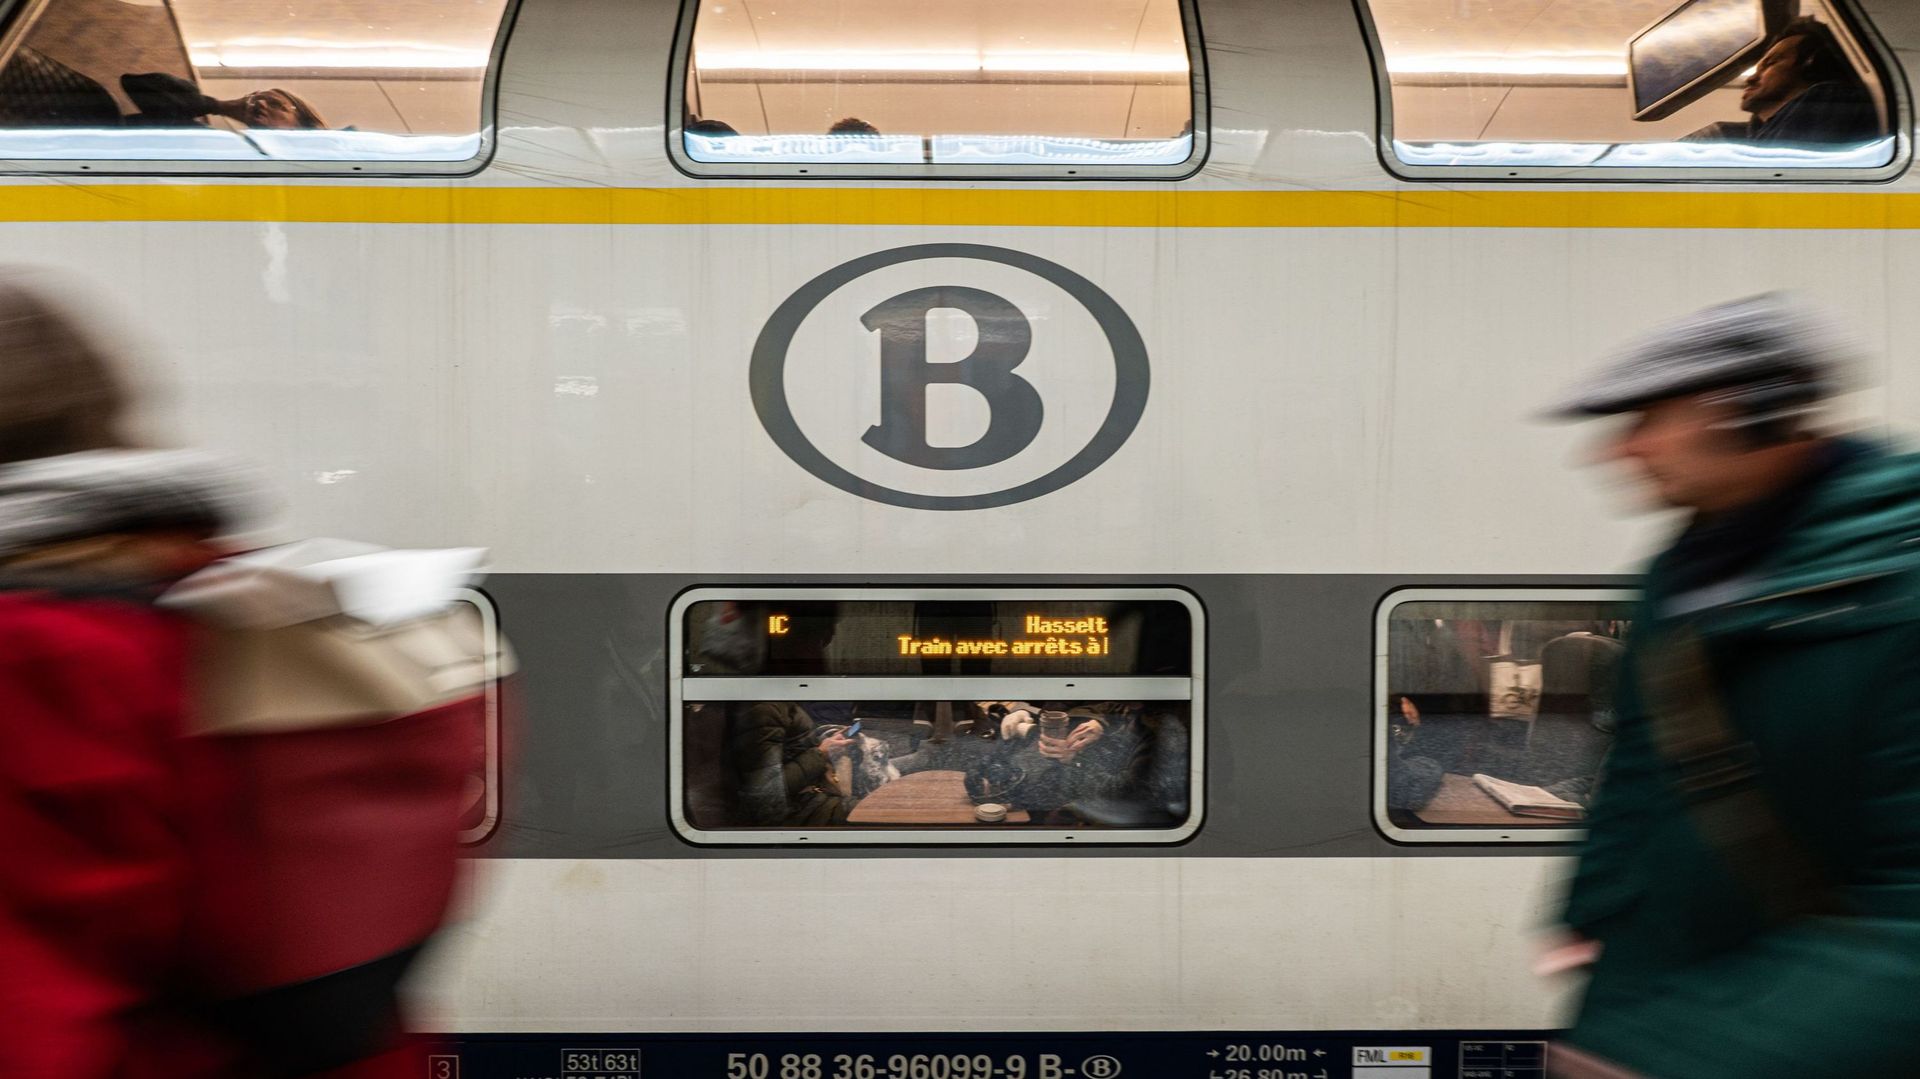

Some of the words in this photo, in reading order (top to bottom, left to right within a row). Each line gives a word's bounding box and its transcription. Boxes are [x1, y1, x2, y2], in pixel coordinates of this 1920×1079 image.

[860, 285, 1044, 470] B
[769, 615, 789, 634] IC
[1025, 615, 1108, 634] Hasselt
[897, 636, 953, 655] Train
[955, 640, 1009, 655] avec
[1011, 637, 1083, 655] arrêts
[1086, 637, 1101, 655] à
[1225, 1044, 1307, 1062] 20.00m
[437, 1060, 450, 1079] 3
[727, 1053, 769, 1079] 50
[780, 1053, 822, 1079] 88
[833, 1054, 1026, 1079] 36-96099-9
